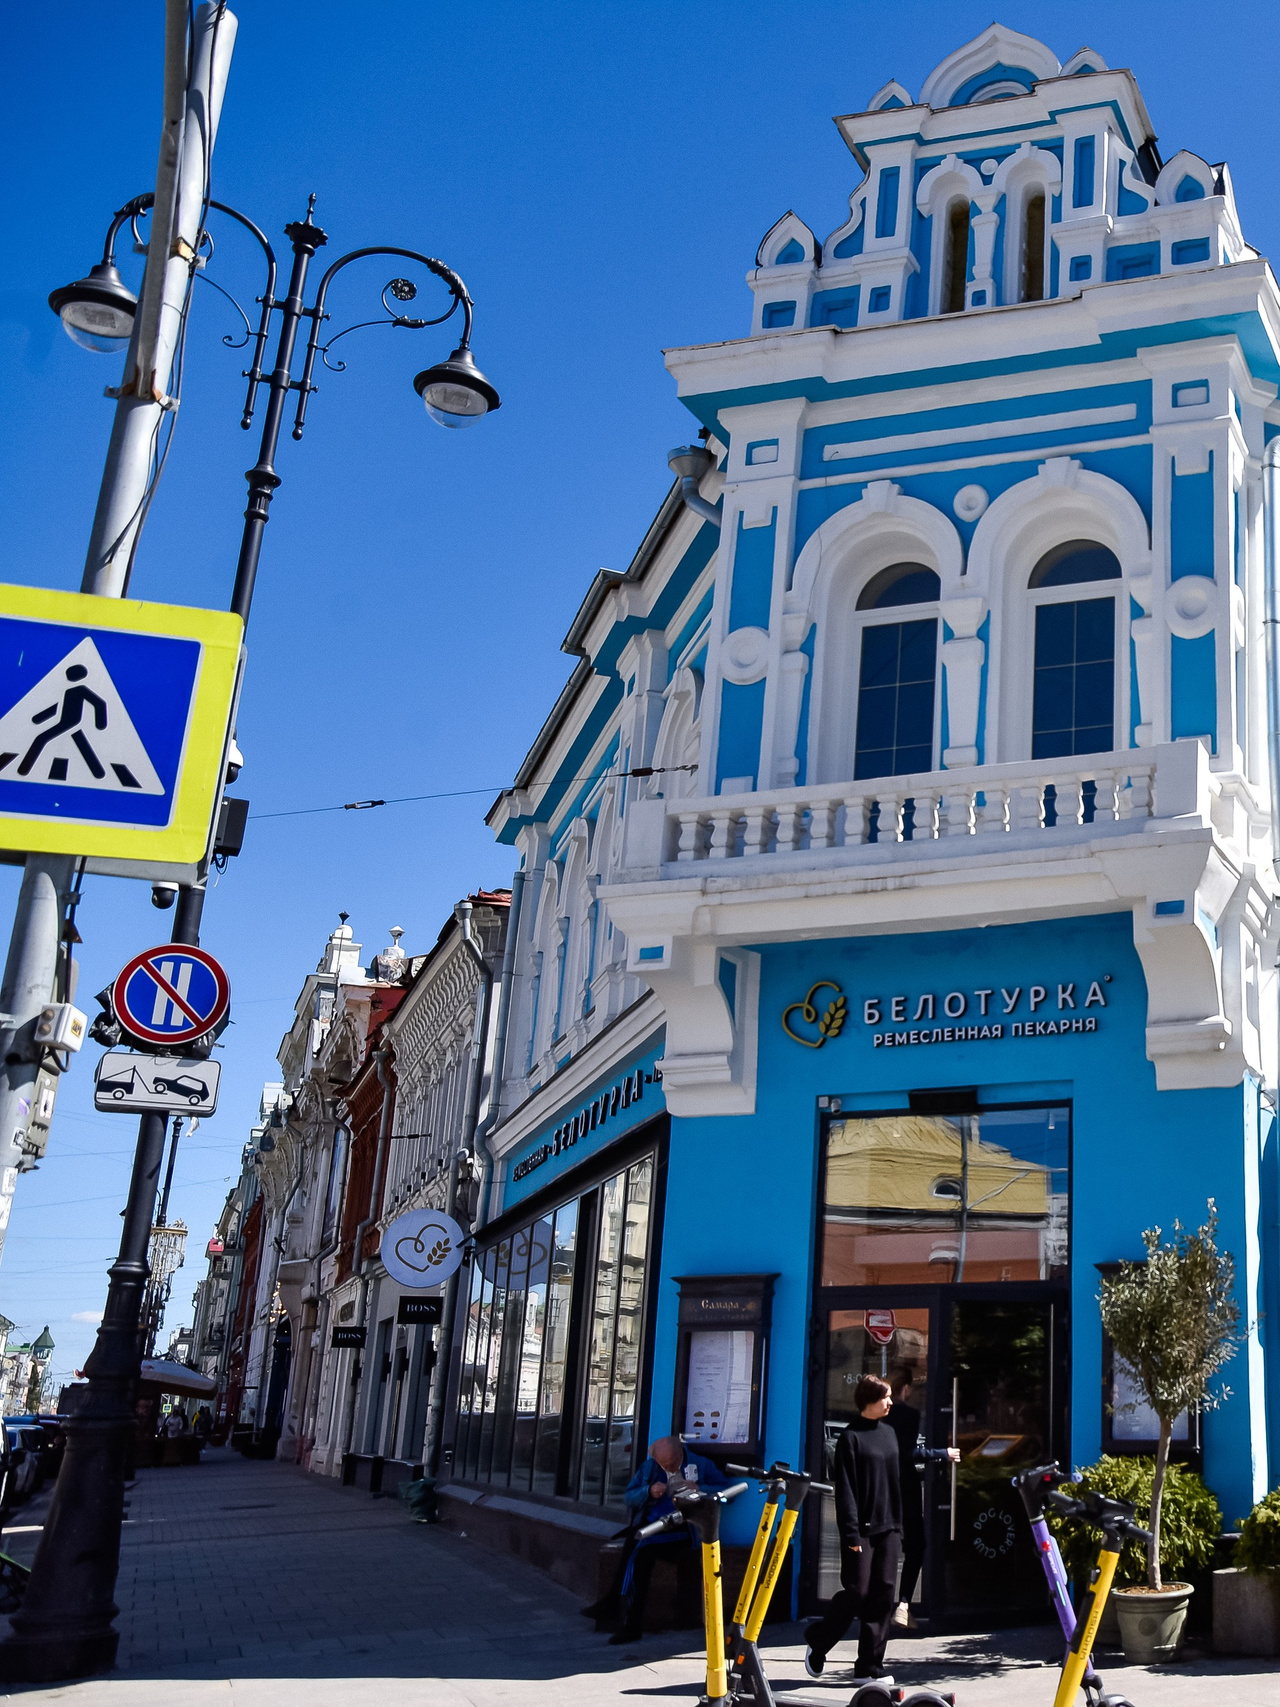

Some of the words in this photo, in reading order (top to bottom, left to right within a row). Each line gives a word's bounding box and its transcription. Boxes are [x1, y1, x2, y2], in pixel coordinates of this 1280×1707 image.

[873, 1024, 1002, 1047] РЕМЕСЛЕННАЯ
[1011, 1017, 1097, 1037] ПЕКАРНЯ
[552, 1069, 642, 1156] БЕЛОТУРКА
[406, 1303, 437, 1313] BOSS
[701, 1299, 739, 1311] Самара
[973, 1507, 996, 1530] DOG
[973, 1537, 997, 1559] CLUB
[764, 1552, 780, 1589] WHOOSH
